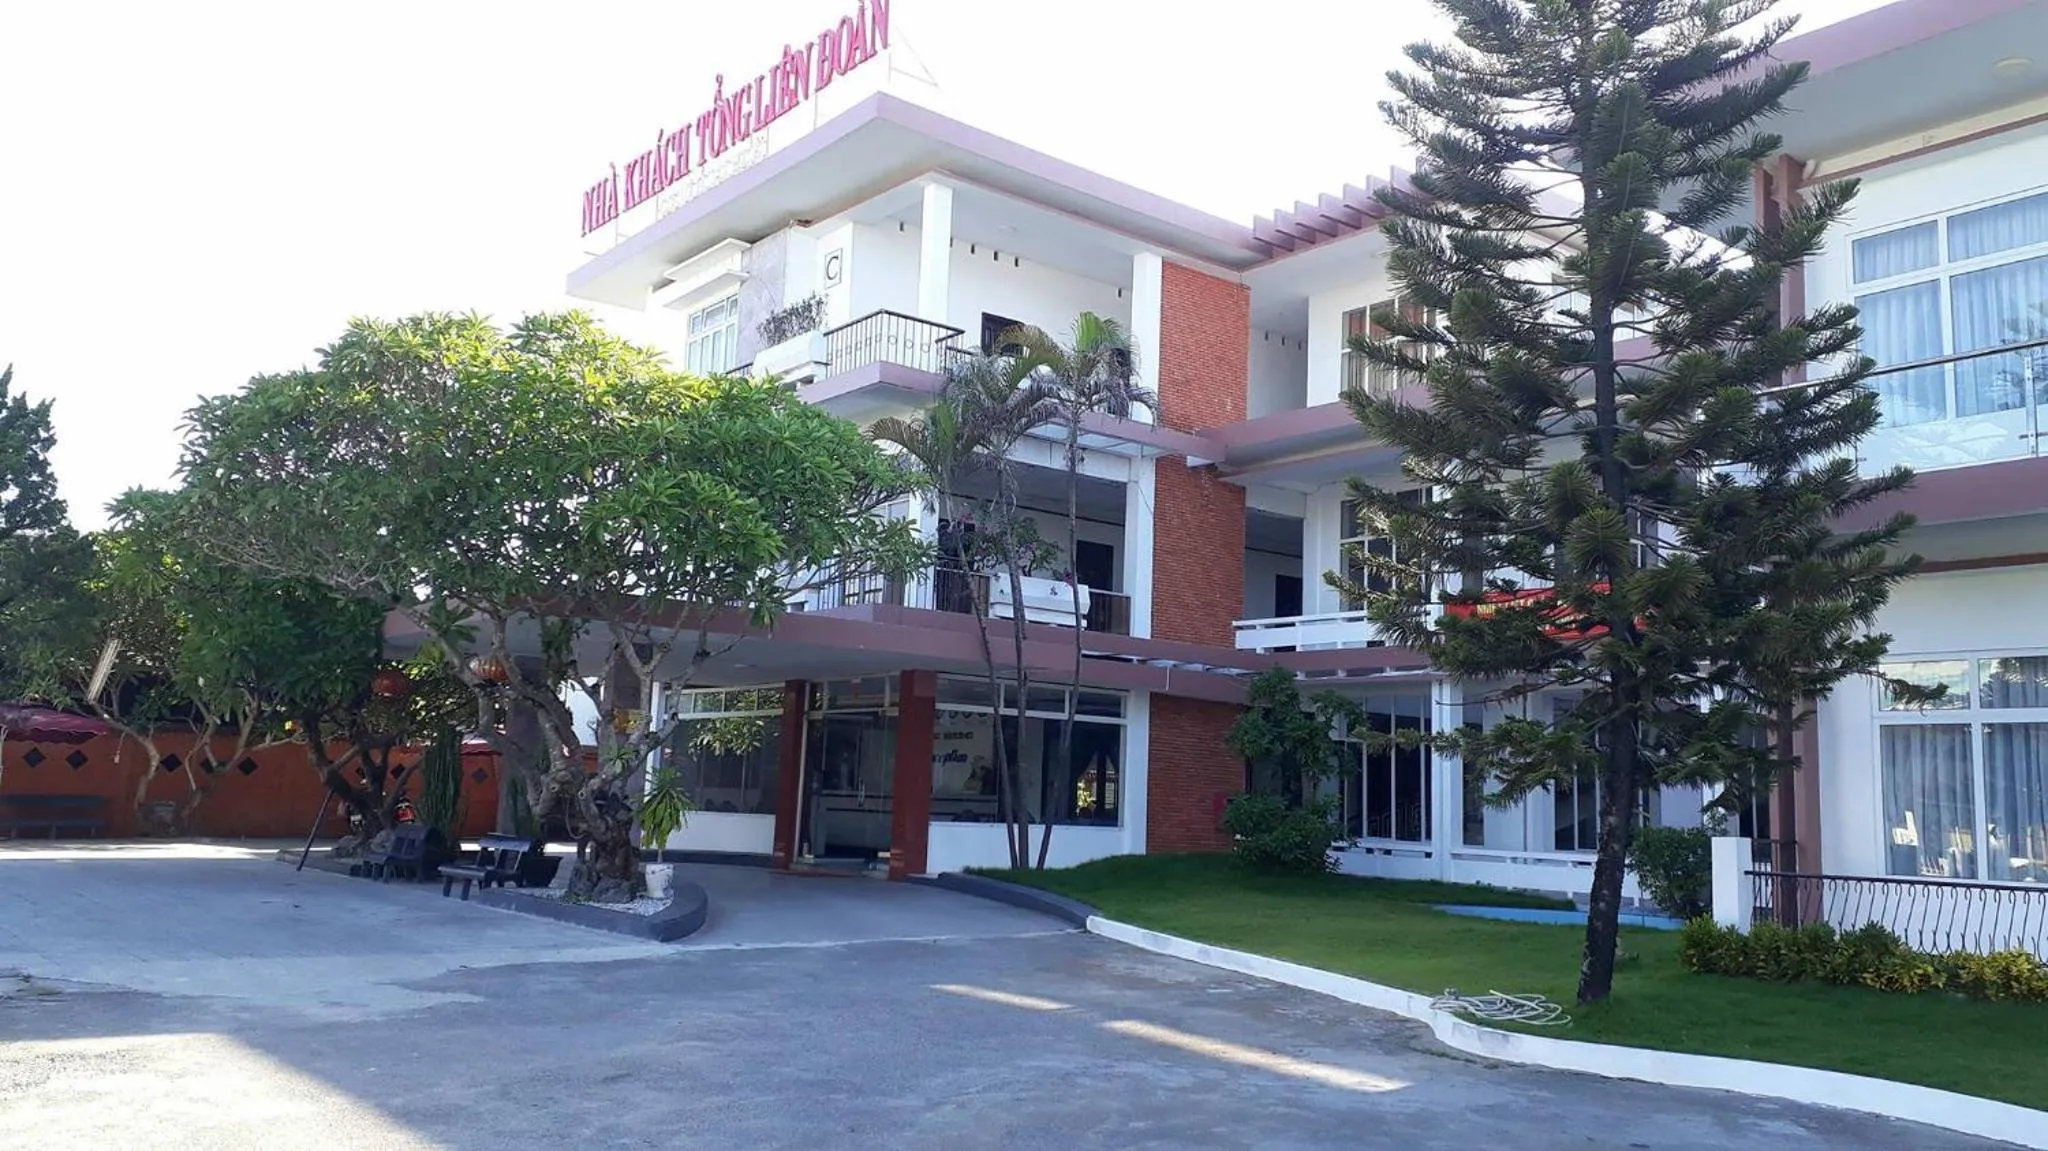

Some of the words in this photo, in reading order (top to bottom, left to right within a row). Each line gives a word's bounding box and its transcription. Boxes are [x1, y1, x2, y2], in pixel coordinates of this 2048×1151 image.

[581, 161, 620, 238] NHÀ
[623, 123, 692, 213] KHÁCH
[696, 73, 752, 167] TỔNG
[752, 42, 814, 133] LIÊN
[826, 255, 839, 281] C
